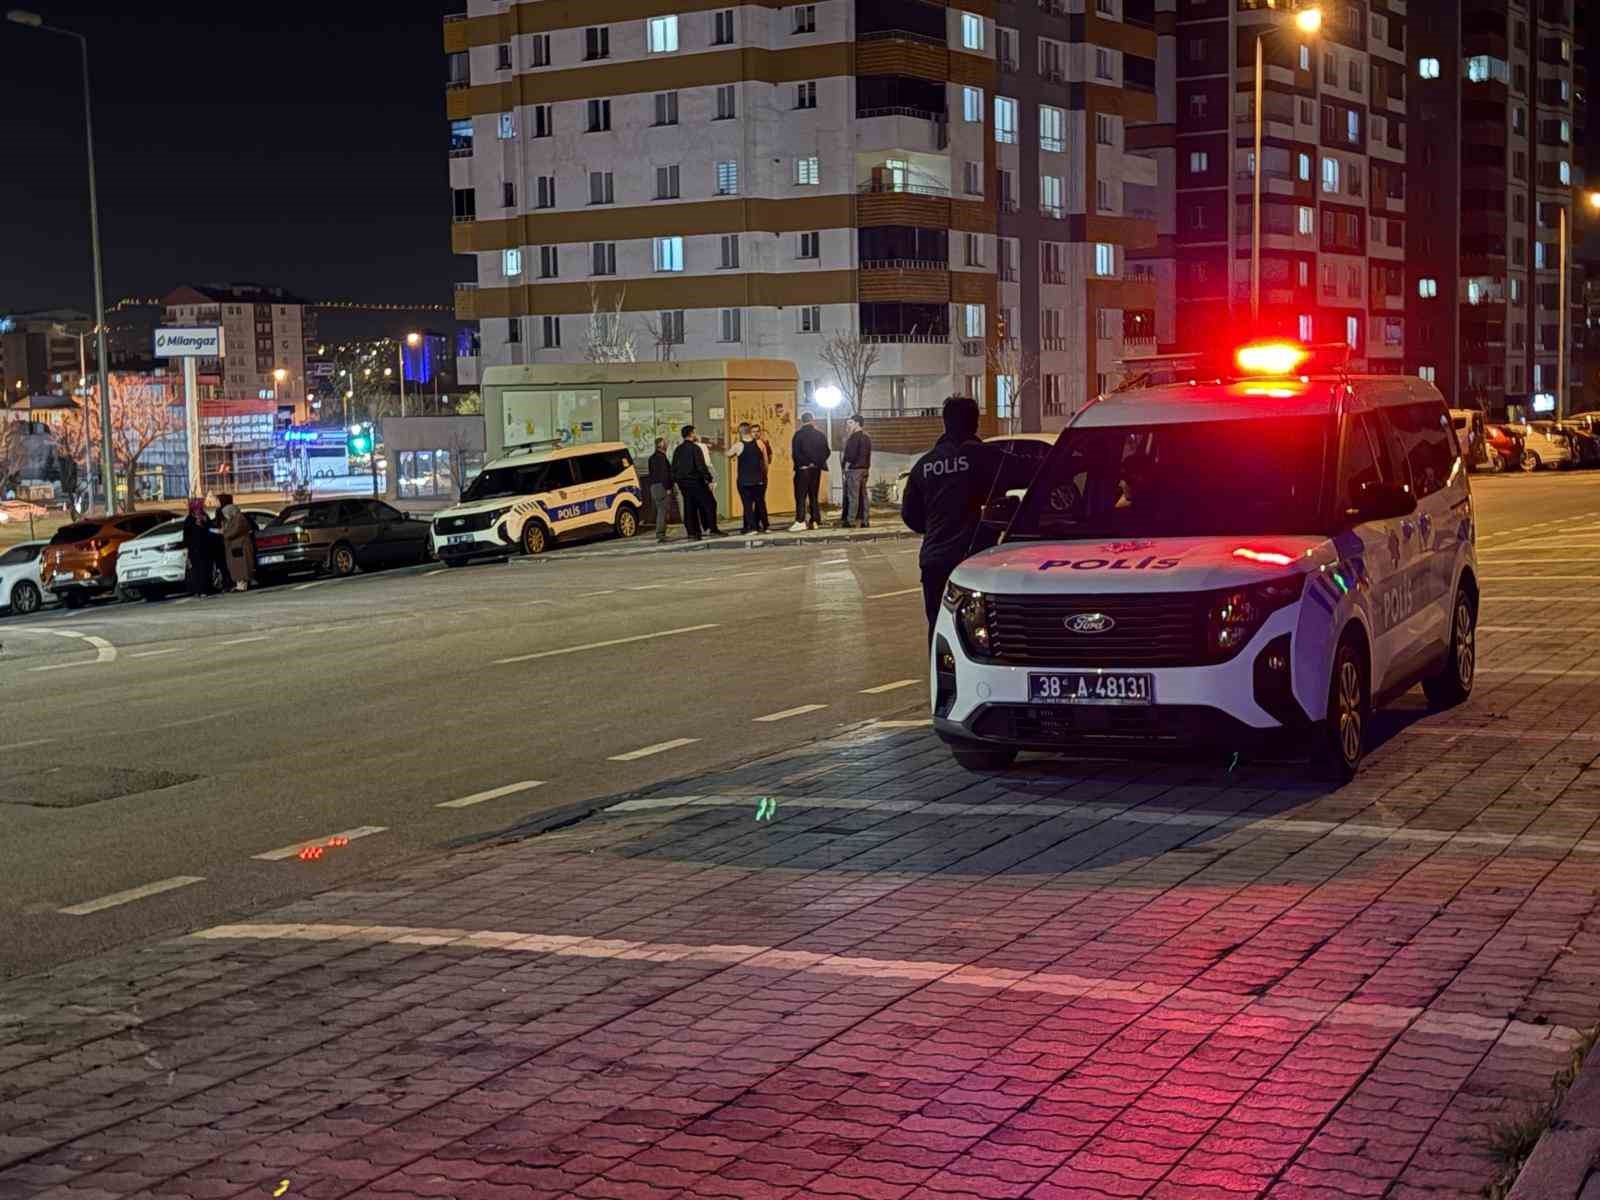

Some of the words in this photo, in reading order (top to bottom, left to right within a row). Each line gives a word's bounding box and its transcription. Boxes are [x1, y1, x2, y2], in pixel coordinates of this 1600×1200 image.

[166, 335, 217, 350] Milangaz
[1073, 614, 1106, 630] Ford
[1039, 676, 1061, 697] 38
[1077, 676, 1088, 697] A
[1095, 676, 1146, 698] 48131
